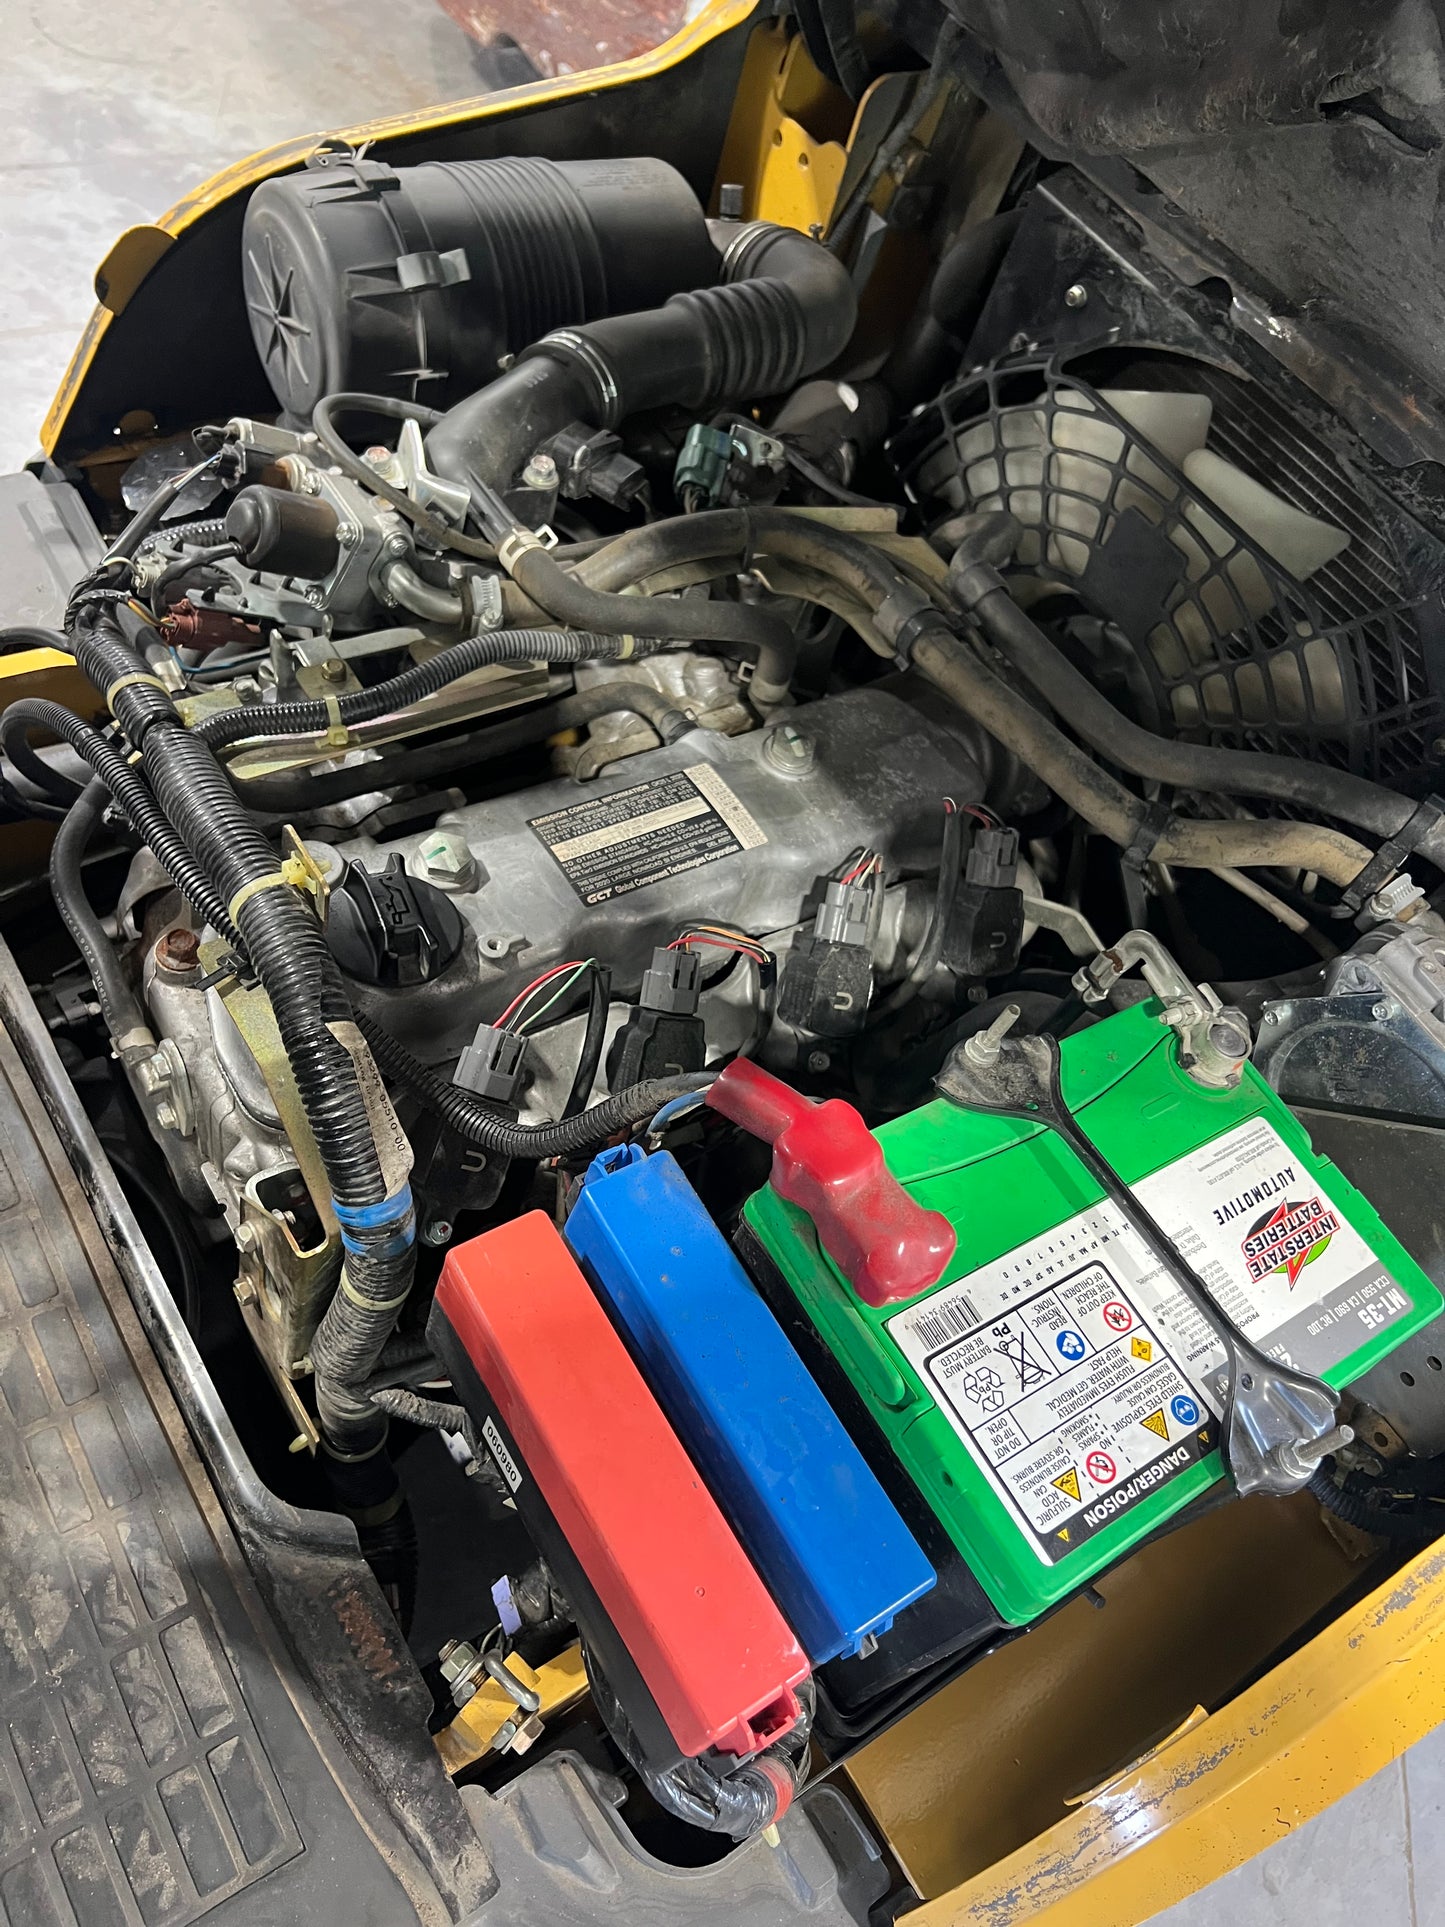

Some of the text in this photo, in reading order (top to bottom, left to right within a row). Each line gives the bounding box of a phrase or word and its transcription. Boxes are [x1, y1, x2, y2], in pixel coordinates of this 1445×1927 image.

[530, 810, 568, 826] EMISSION
[567, 799, 602, 814] CONTROL
[600, 784, 650, 803] INFORMATION
[575, 851, 601, 863] OTHER
[603, 833, 656, 853] ADJUSTMENTS
[585, 842, 740, 904] GCT Global Component Technologies Corporation
[1210, 1166, 1299, 1225] AUTOMOTIVE
[1102, 1215, 1108, 1223] 1
[1121, 1222, 1130, 1231] JA
[1241, 1200, 1325, 1258] BATTERIES
[1069, 1233, 1076, 1241] 4
[1089, 1240, 1098, 1249] AP
[1110, 1228, 1119, 1237] FE
[1078, 1246, 1088, 1256] MA
[1246, 1214, 1339, 1278] INTERSTATE
[1056, 1259, 1065, 1268] JL
[1034, 1271, 1043, 1281] SP
[1059, 1271, 1103, 1301] OF CHILDREN.
[938, 1295, 961, 1311] 56489
[1074, 1279, 1109, 1305] THE REACH
[1075, 1288, 1116, 1317] KEEP OUT OF
[915, 1307, 938, 1324] 34141
[1029, 1305, 1061, 1329] INSTRUC-
[1030, 1296, 1054, 1314] TIONS.
[1305, 1274, 1390, 1336] CCA 550 CA 690 RC 100
[1355, 1286, 1407, 1330] MT-35
[990, 1321, 1010, 1339] Pb
[1047, 1314, 1067, 1331] READ
[936, 1336, 984, 1368] BE RECYCLED.
[941, 1344, 991, 1378] BATTERY MUST
[1086, 1345, 1122, 1371] HELP FAST.
[1185, 1339, 1215, 1362] WARNING
[977, 1382, 991, 1394] Pb
[1045, 1354, 1128, 1412] WITH WATER. GET MEDICAL
[1054, 1363, 1135, 1419] FLUSH EYES IMMEDIATELY
[1110, 1362, 1170, 1404] BLINDNESS OR INJURY.
[1126, 1370, 1177, 1407] GASES CAN CAUSE
[1110, 1380, 1183, 1433] SHIELD EYES. EXPLOSIVE
[984, 1416, 1007, 1436] OPEN.
[990, 1426, 1014, 1446] TIP OR
[1059, 1414, 1089, 1437] SMOKING
[1070, 1422, 1095, 1442] FLAMES
[992, 1436, 1021, 1459] DO NOT
[1077, 1431, 1101, 1450] SPARKS
[1098, 1437, 1112, 1450] NO
[486, 1425, 517, 1482] 060980
[1009, 1445, 1064, 1484] OR SEVERE BURNS.
[1018, 1454, 1070, 1493] CAUSE BLINDNESS
[1032, 1483, 1047, 1498] CAN
[1040, 1489, 1060, 1508] ACID
[1082, 1445, 1190, 1528] DANGER/POISON
[1035, 1496, 1071, 1526] SULFURIC
